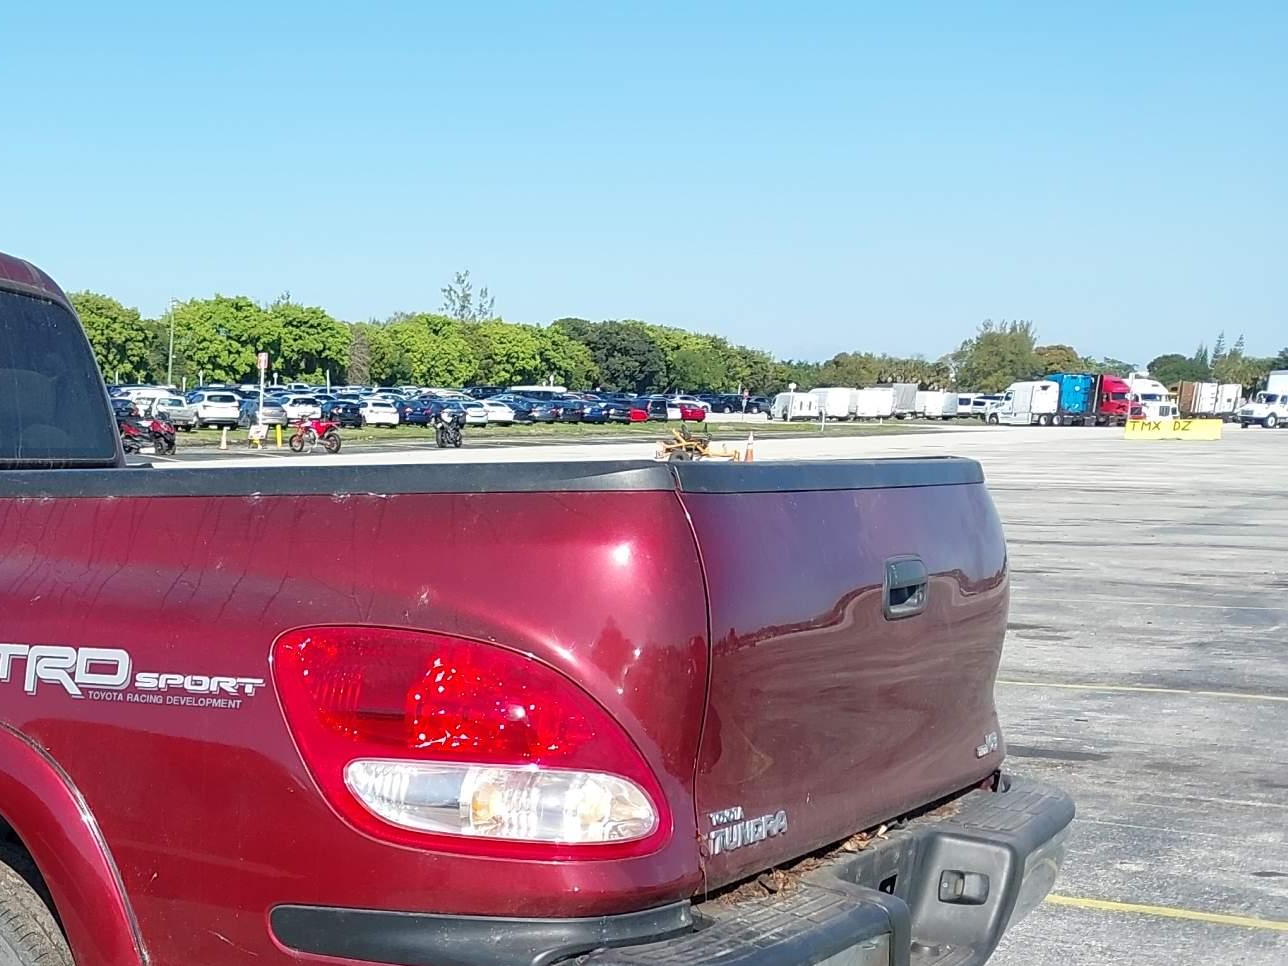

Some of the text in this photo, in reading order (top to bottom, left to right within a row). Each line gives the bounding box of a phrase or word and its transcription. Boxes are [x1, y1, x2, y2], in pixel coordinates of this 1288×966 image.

[1129, 420, 1162, 432] TMX
[133, 671, 266, 697] SPORT
[87, 689, 242, 710] TOYOTA RACING DEVELOPMENT
[709, 810, 789, 855] TUNDRA
